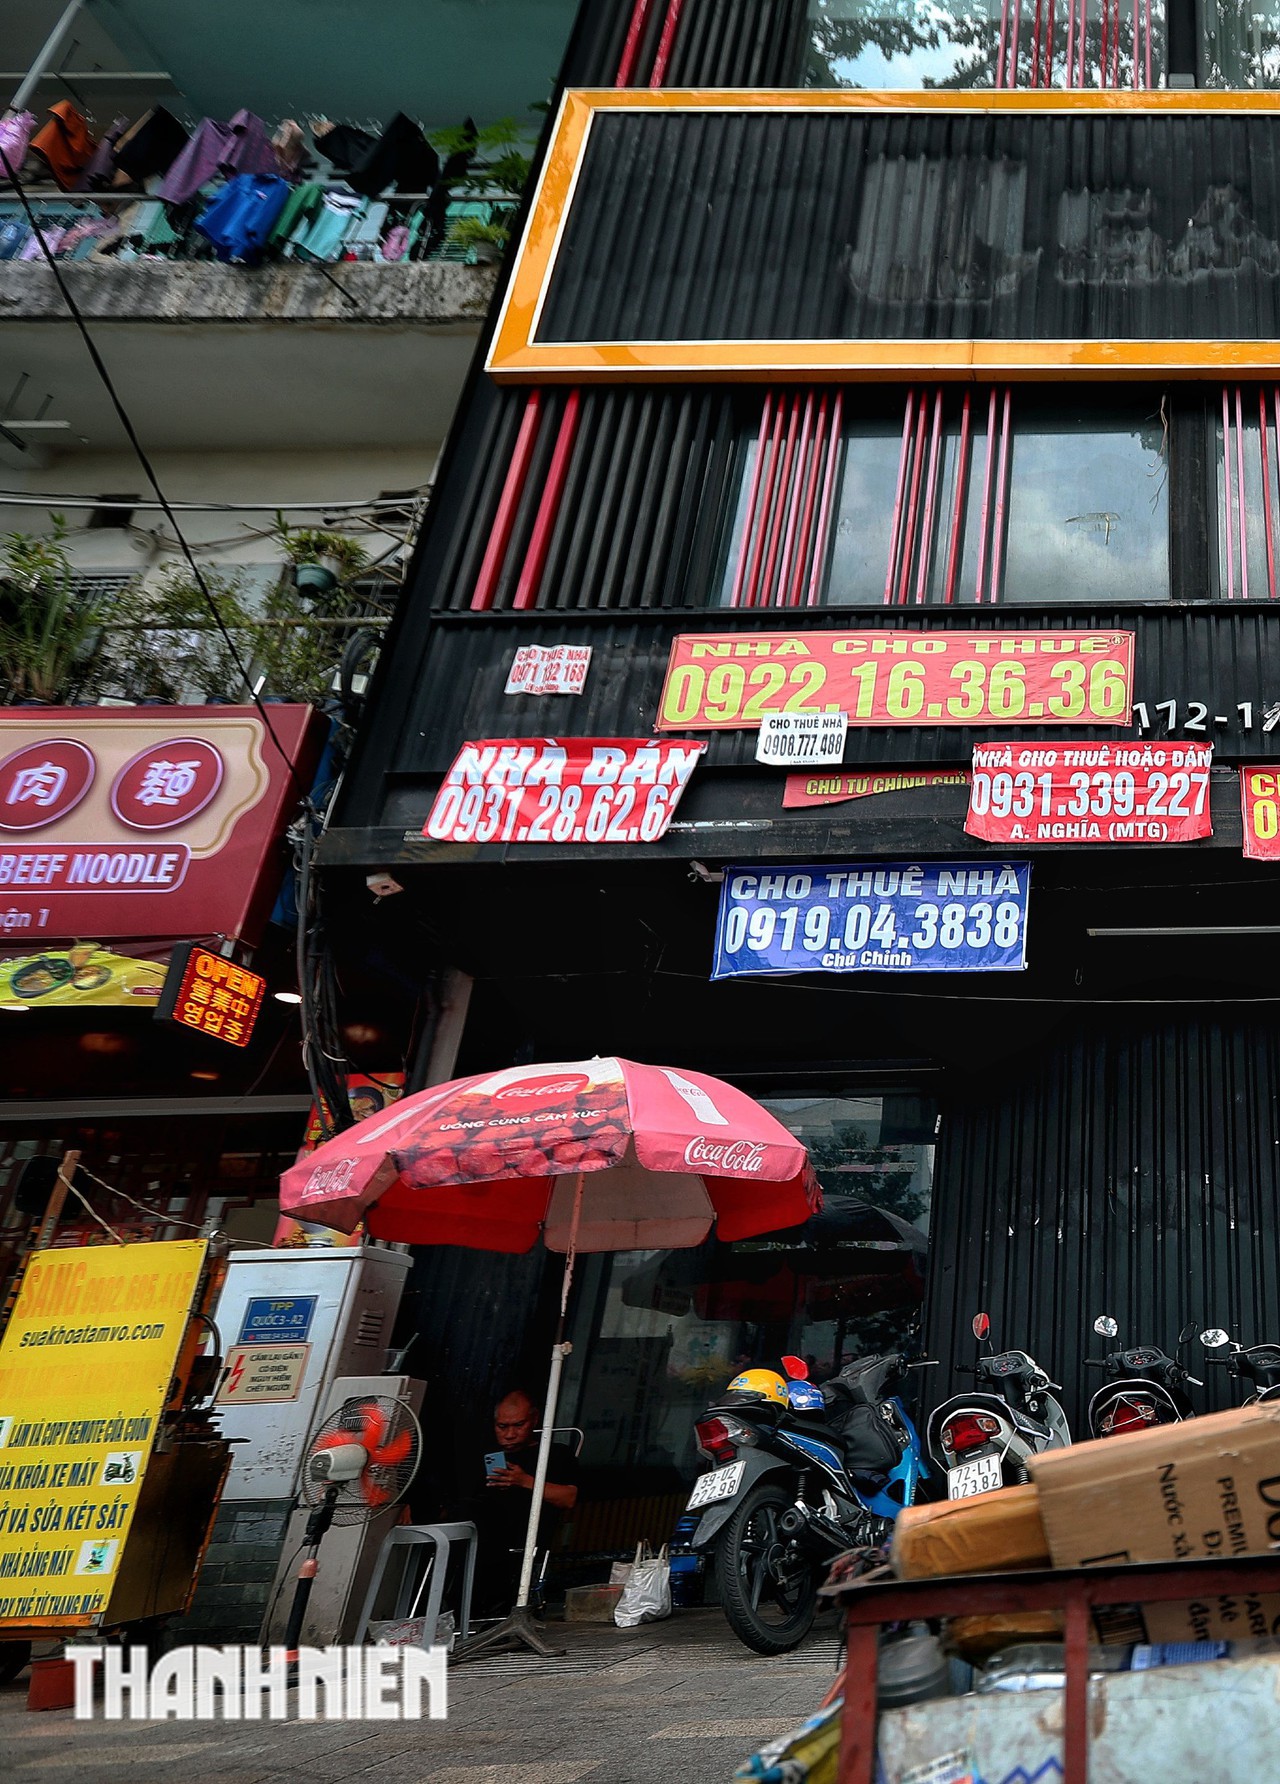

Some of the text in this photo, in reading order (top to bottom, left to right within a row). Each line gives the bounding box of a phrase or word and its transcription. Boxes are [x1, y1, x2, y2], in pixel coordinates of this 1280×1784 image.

[516, 648, 537, 662] CHO
[567, 647, 589, 660] NHÀ
[692, 636, 1111, 658] NHÀ CHO THUÊ
[662, 660, 1126, 722] 0922.16.36.36
[769, 715, 842, 729] CHO THUÊ NHÀ
[763, 733, 843, 756] 0908.777.488
[974, 746, 1012, 767] NHÀ
[1019, 750, 1057, 767] CHO
[1063, 745, 1112, 767] THUÊ
[1115, 745, 1166, 772] HOẶC
[447, 738, 701, 786] NHÀ BÁN
[806, 776, 841, 795] CHÚ
[971, 772, 1209, 818] 0931.339.227
[1010, 819, 1169, 842] A. NGHĨA (MTG)
[0, 853, 180, 885] BEEF NOODLE
[730, 865, 1021, 900] CHO THUÊ NHÀ
[37, 908, 51, 928] 1
[725, 902, 1021, 954] 0919.04.3838
[821, 951, 855, 967] Chú
[195, 954, 259, 999] OPEN
[269, 1302, 295, 1311] TPP
[13, 1459, 50, 1489] KHÓA
[48, 1463, 70, 1488] XE
[66, 1457, 100, 1486] MÁY
[701, 1466, 737, 1489] 59-U2
[957, 1458, 991, 1483] 72-L1
[690, 1479, 737, 1508] 222.98
[952, 1472, 998, 1500] 023.82
[1157, 1463, 1185, 1526] Nước
[7, 1502, 29, 1533] VÀ
[30, 1498, 63, 1532] SỬA
[64, 1500, 97, 1530] KÉT
[96, 1494, 129, 1529] SẮT
[47, 1544, 75, 1575] MÁY
